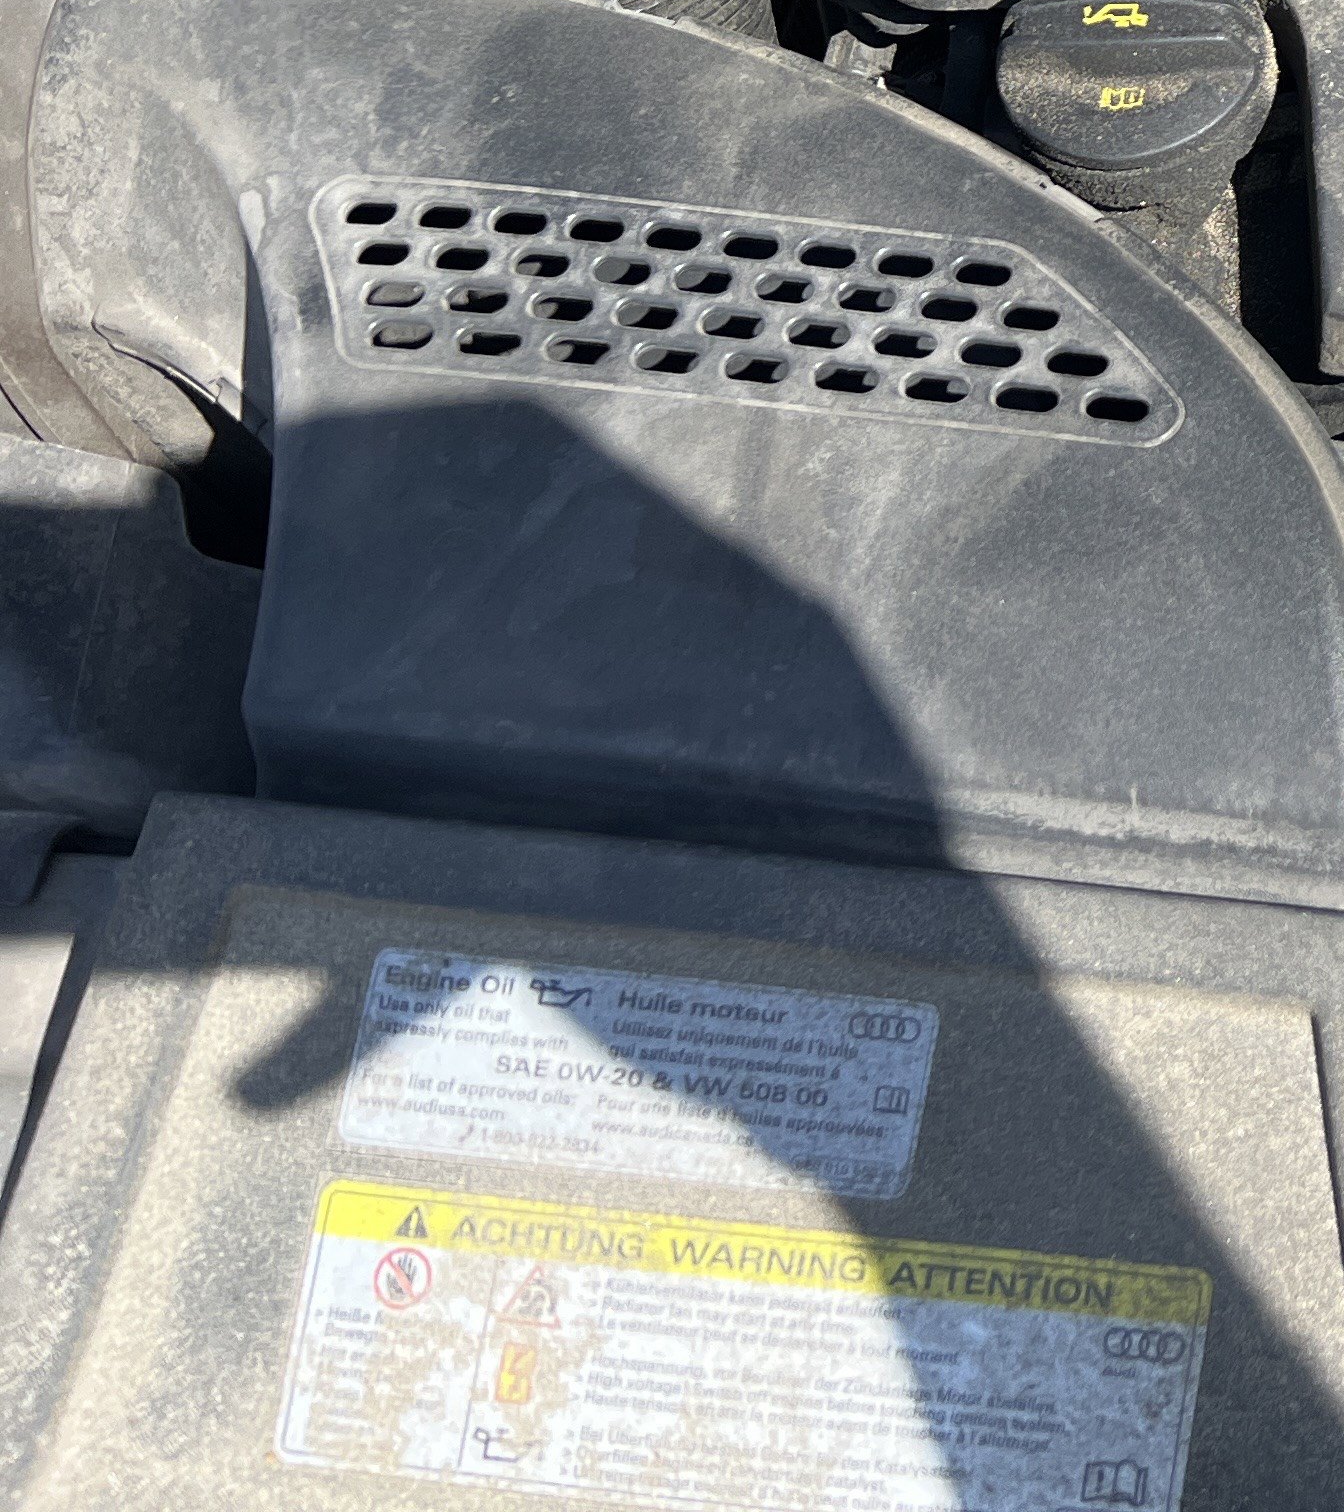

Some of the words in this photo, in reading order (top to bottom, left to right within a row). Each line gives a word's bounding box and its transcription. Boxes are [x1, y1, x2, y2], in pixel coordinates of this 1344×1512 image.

[384, 966, 470, 994] Engine
[481, 977, 514, 995] Oil
[378, 996, 409, 1011] Use
[413, 1001, 447, 1015] only
[452, 1002, 474, 1020] oil
[478, 1007, 511, 1022] that
[617, 990, 682, 1013] Huile
[690, 1000, 789, 1025] moteur
[454, 1027, 528, 1047] complies
[534, 1035, 568, 1050] with
[677, 1029, 777, 1053] uniquement
[781, 1037, 805, 1053] de
[608, 1042, 636, 1060] qui
[638, 1046, 704, 1064] satisfait
[407, 1074, 433, 1091] list
[436, 1076, 455, 1094] of
[458, 1081, 537, 1103] approved
[495, 1054, 552, 1079] SAE
[557, 1061, 644, 1089] 0W-20
[651, 1071, 674, 1093] &
[682, 1075, 733, 1097] VW
[795, 1088, 829, 1105] 00
[358, 1093, 505, 1122] www.audiusa.com
[452, 1215, 643, 1263] ACHTUNG
[670, 1237, 867, 1285] WARNING
[889, 1261, 1115, 1308] ATTENTION
[587, 1373, 622, 1387] High
[1102, 1366, 1136, 1379] Audi
